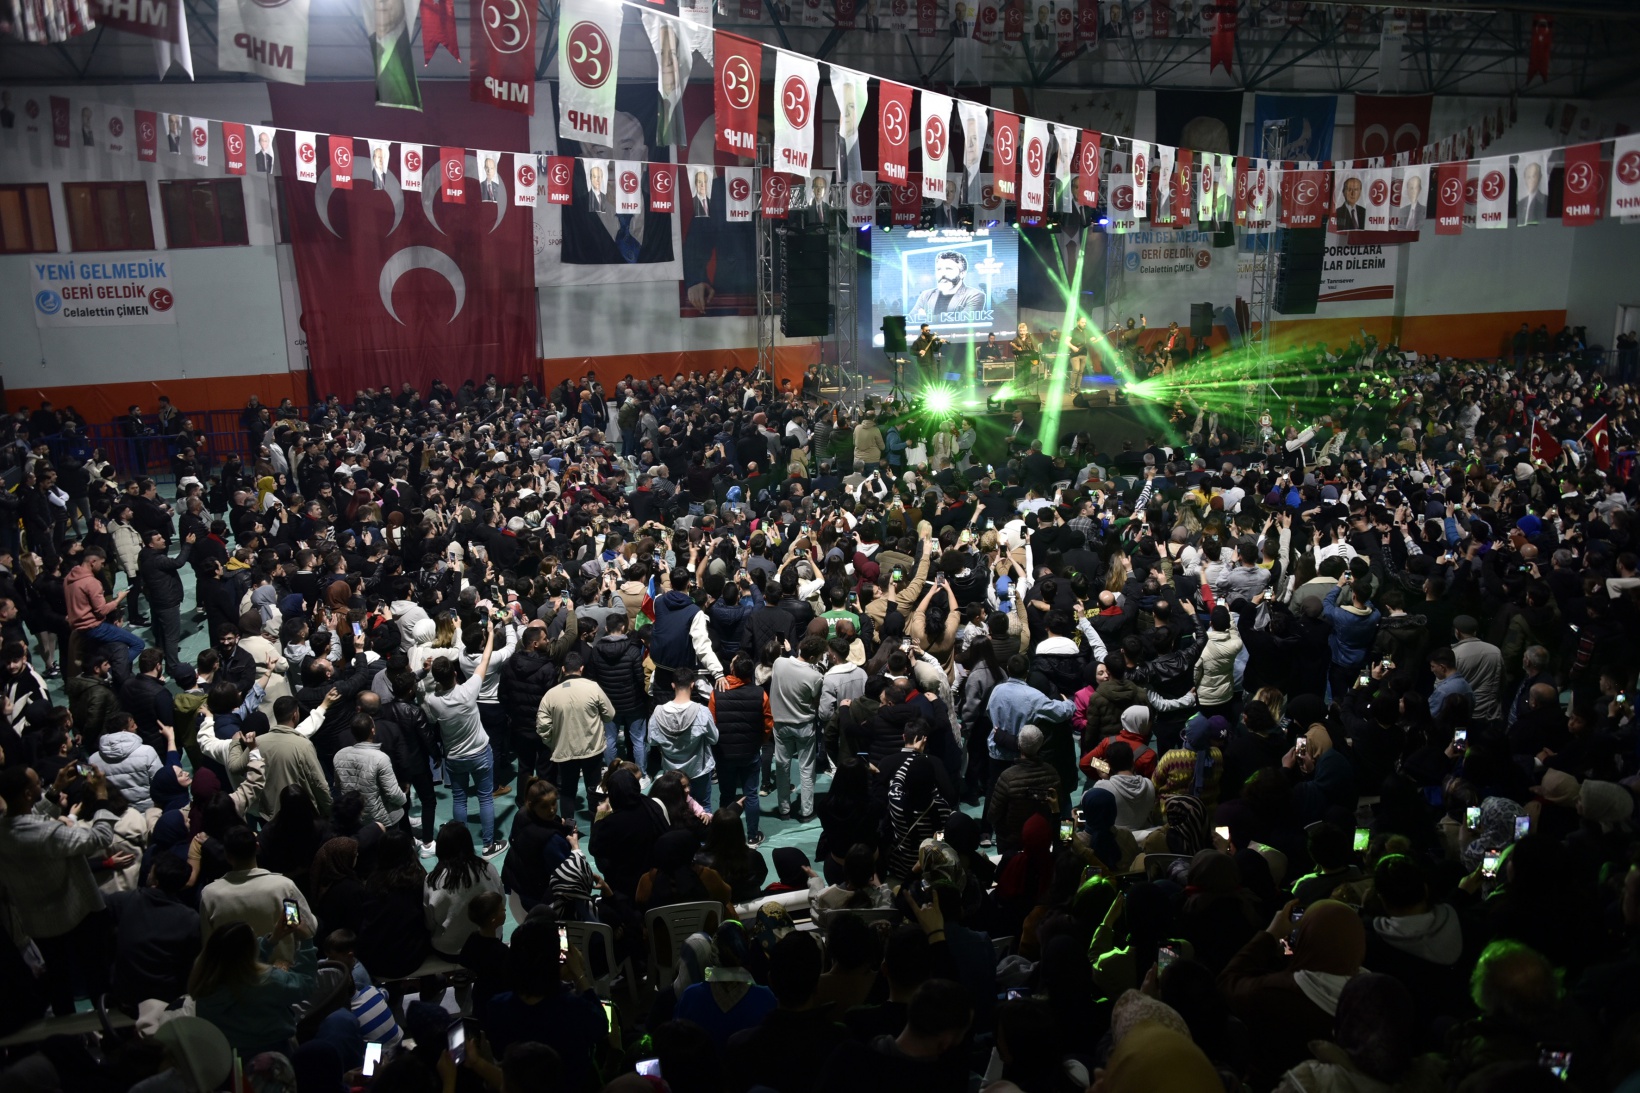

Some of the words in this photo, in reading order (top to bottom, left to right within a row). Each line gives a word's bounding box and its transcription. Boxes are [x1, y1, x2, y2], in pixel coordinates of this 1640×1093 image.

[446, 188, 463, 196] MHP
[551, 193, 570, 201] MHP
[895, 213, 916, 221] MHP
[1113, 221, 1135, 229] MHP
[1128, 230, 1153, 243] YENİ
[1142, 246, 1162, 259] GERİ
[1164, 246, 1194, 259] GELDİK
[1324, 245, 1382, 256] PORCULARA
[36, 260, 75, 280] YENİ
[80, 259, 166, 279] GELMEDİK
[1140, 264, 1172, 273] Celalettin
[1174, 263, 1194, 274] ÇİMEN
[1324, 260, 1342, 270] LAR
[1346, 257, 1385, 270] DİLERİM
[62, 283, 93, 299] GERİ
[97, 282, 146, 298] GELDİK
[64, 307, 114, 317] Celalettin
[117, 304, 148, 318] ÇİMEN
[940, 310, 994, 322] KINIK
